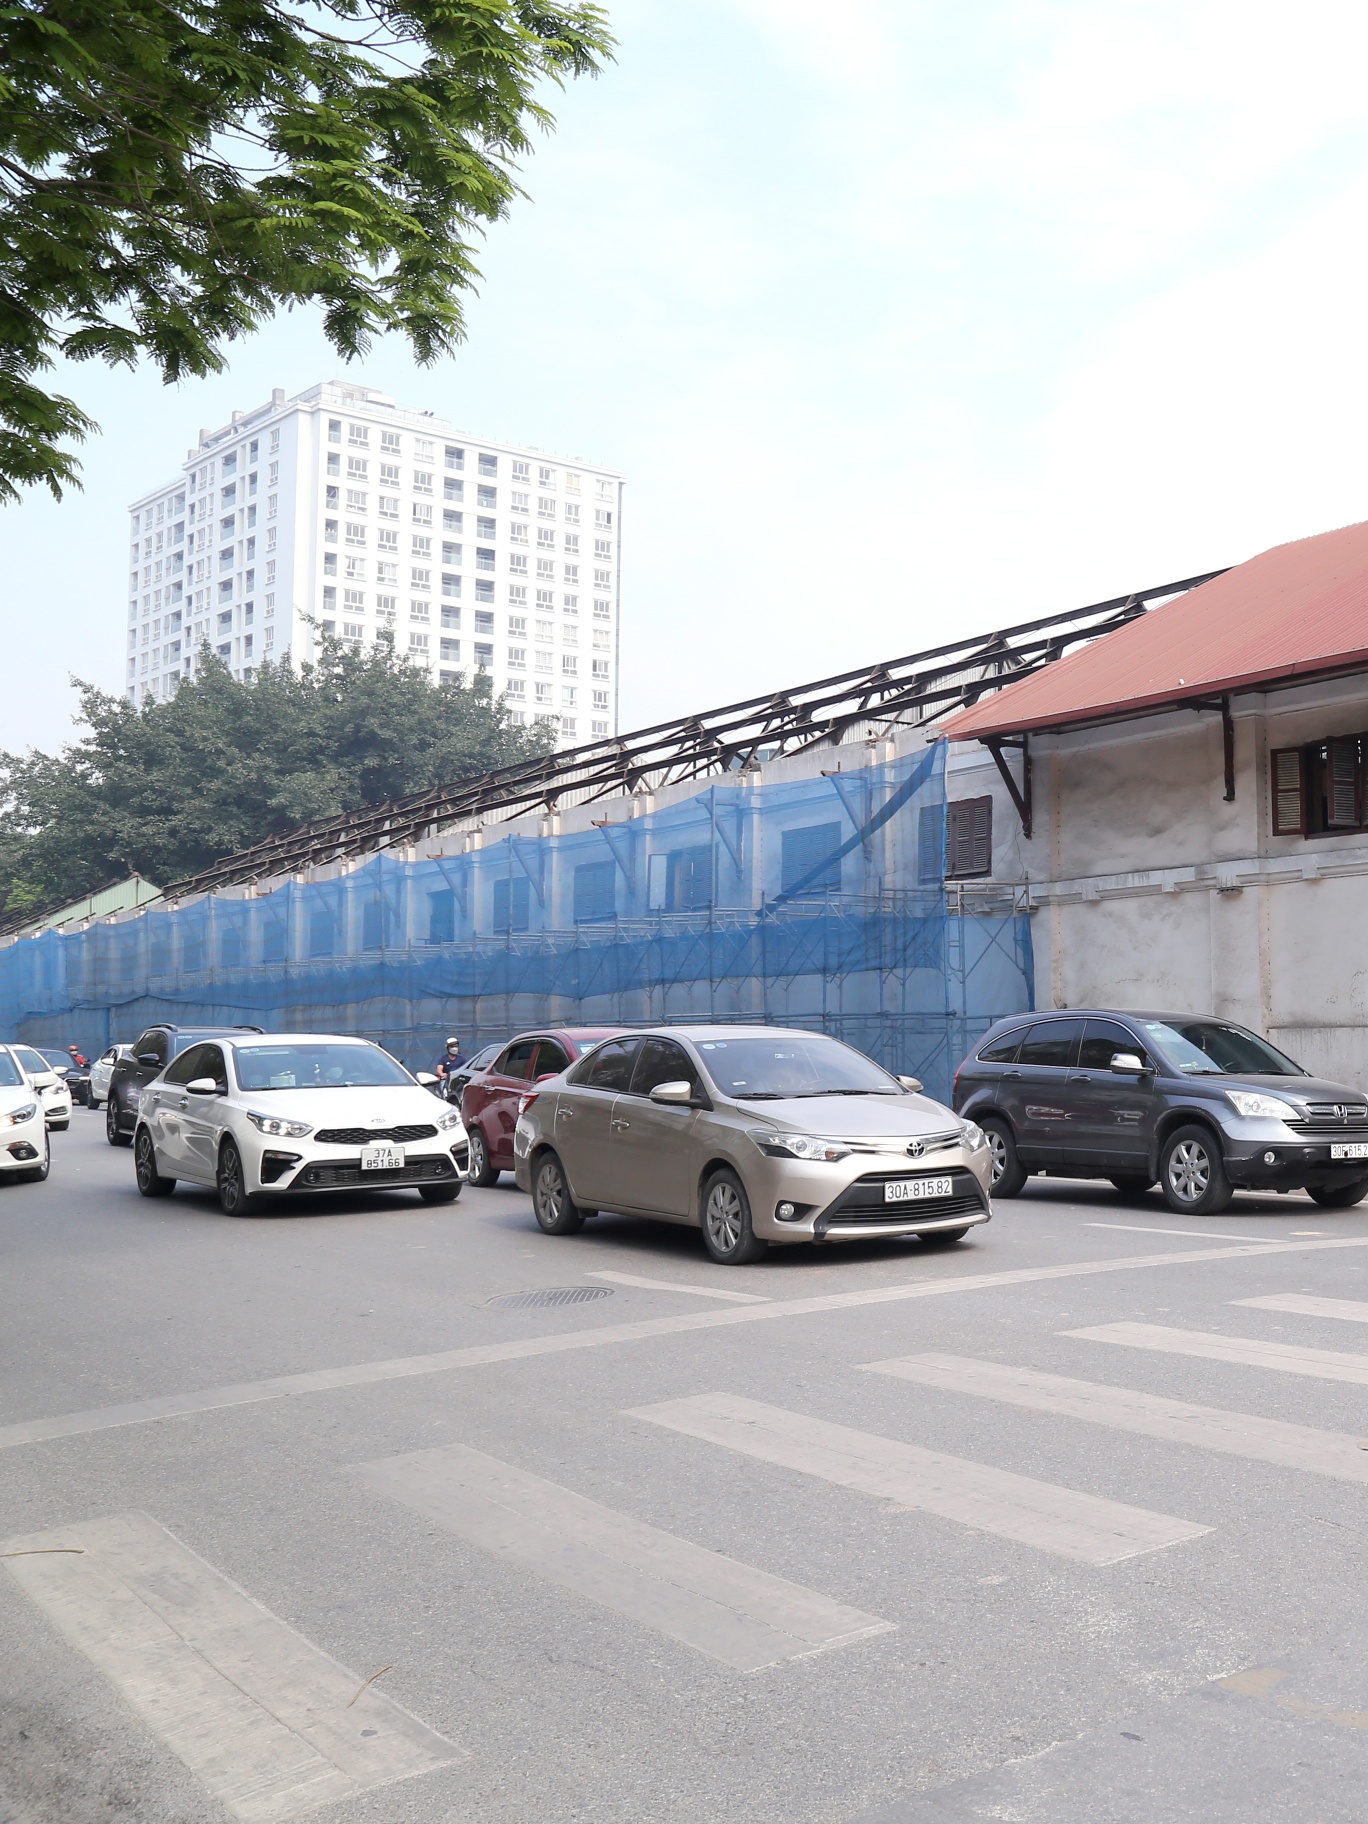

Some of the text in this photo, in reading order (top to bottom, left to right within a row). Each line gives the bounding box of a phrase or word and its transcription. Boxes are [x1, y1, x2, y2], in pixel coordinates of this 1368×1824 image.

[374, 1148, 392, 1158] 37A
[366, 1158, 400, 1168] 851.66
[887, 1179, 950, 1200] 30A-815.82
